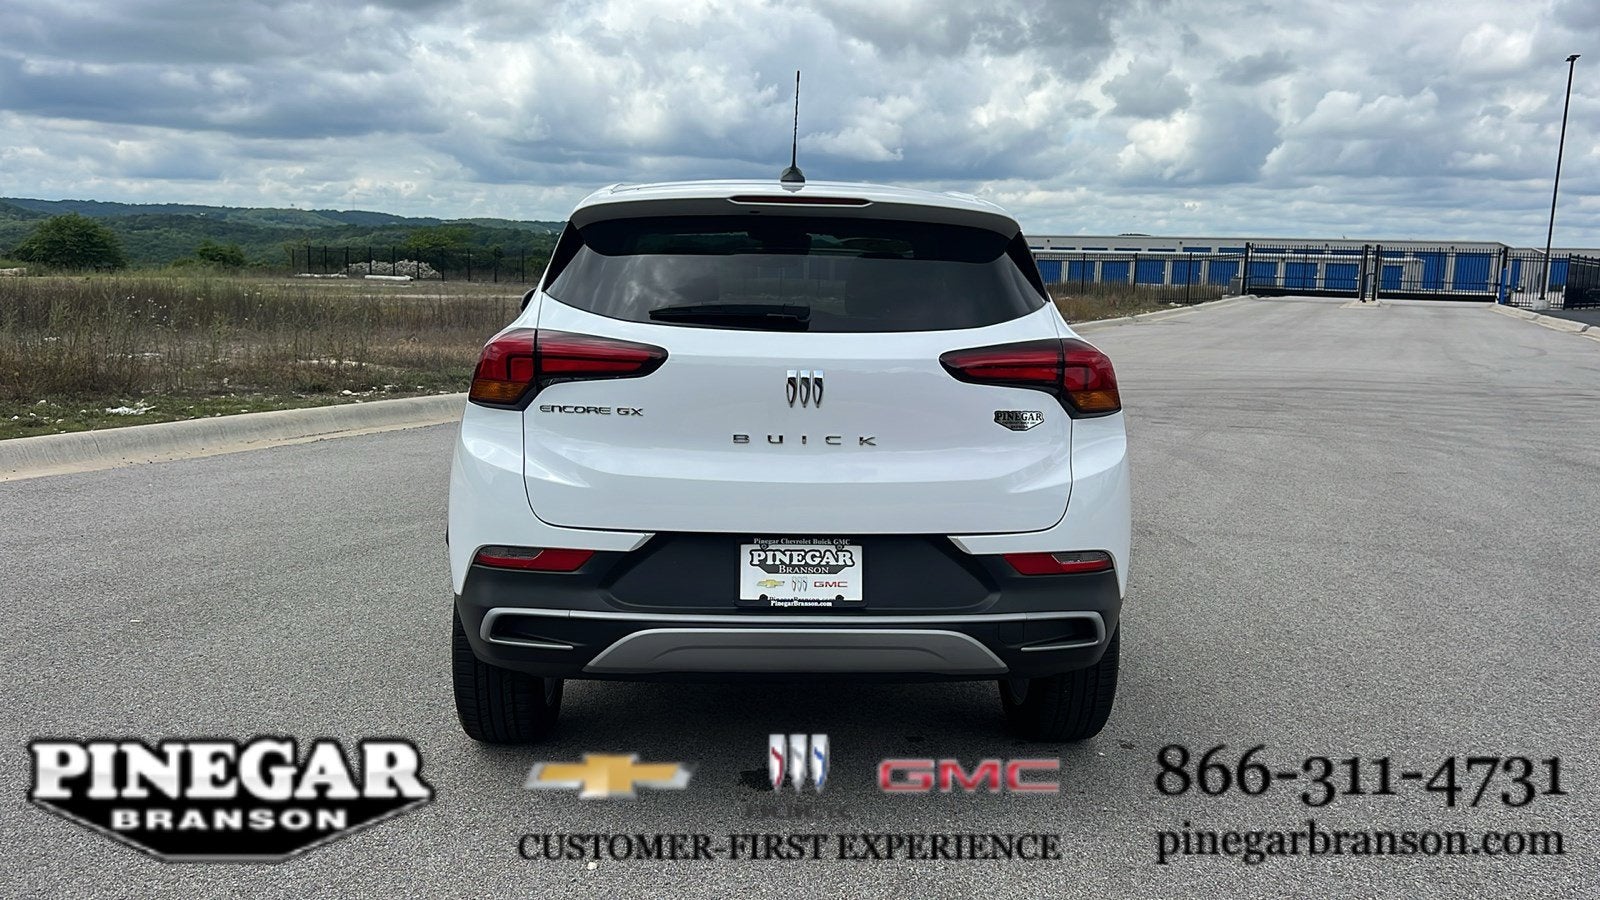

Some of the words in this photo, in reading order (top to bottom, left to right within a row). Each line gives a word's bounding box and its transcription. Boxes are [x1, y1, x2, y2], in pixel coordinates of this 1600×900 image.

[539, 404, 611, 415] ENCORE
[616, 406, 643, 417] GX
[995, 411, 1043, 421] PINEGAR
[733, 433, 877, 447] BUICK
[750, 550, 855, 566] PINEGAR
[779, 565, 829, 574] BRANSON
